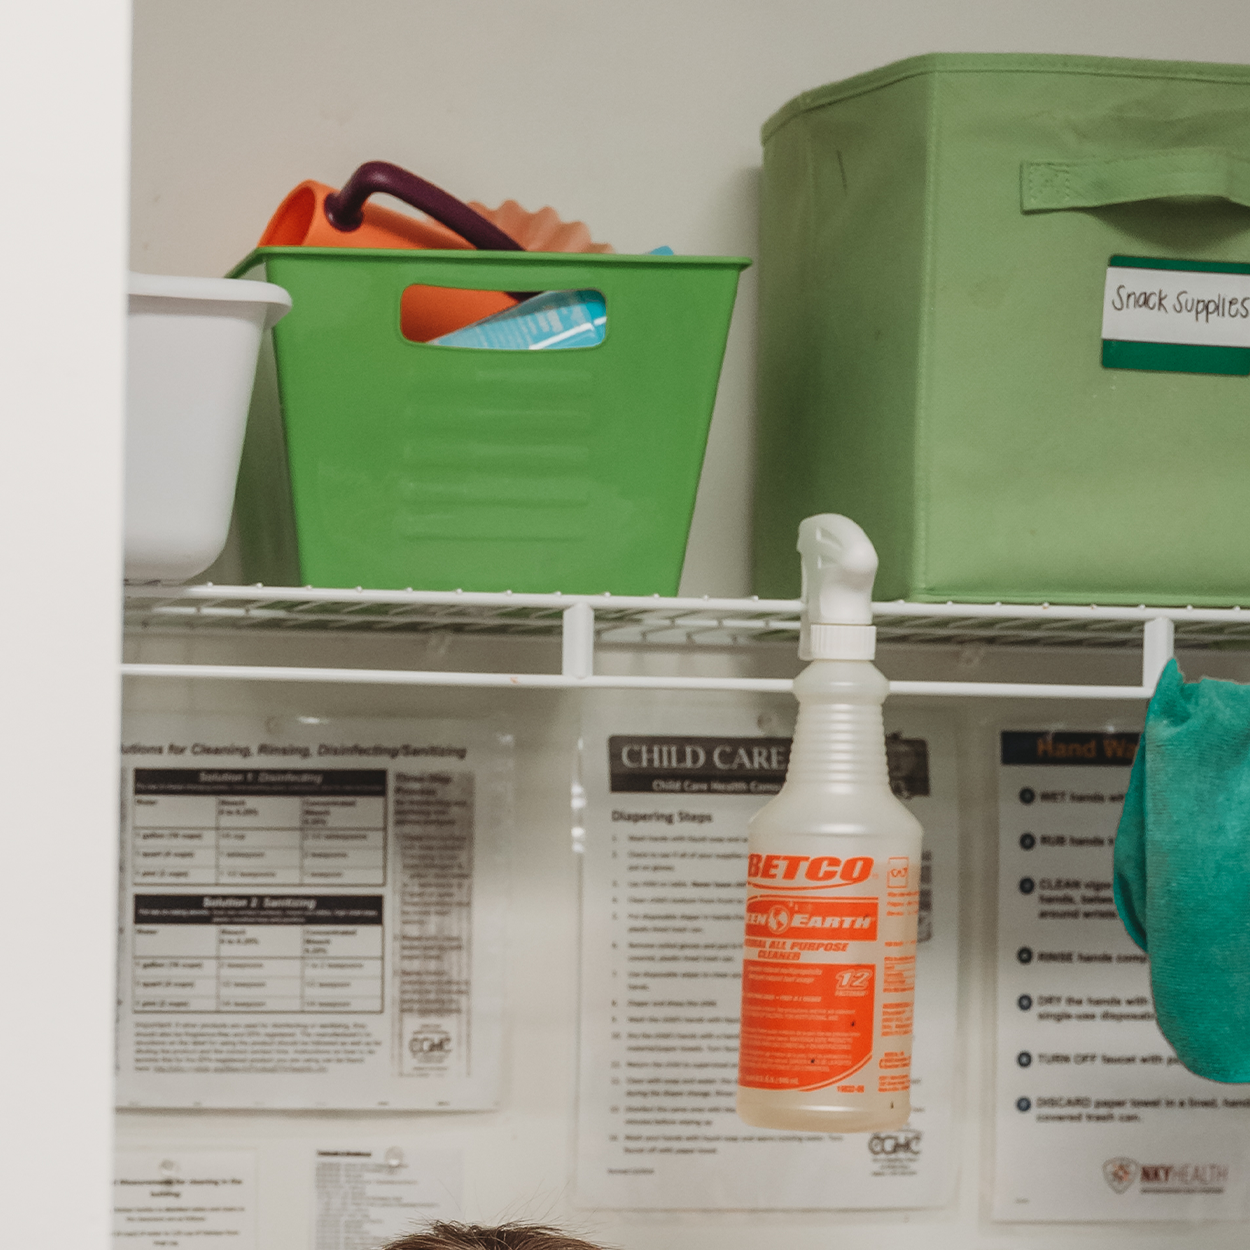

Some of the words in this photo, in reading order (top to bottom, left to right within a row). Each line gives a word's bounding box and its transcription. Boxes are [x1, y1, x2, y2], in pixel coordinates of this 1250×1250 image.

[1111, 284, 1169, 314] Snack
[1172, 290, 1250, 324] Supplies
[167, 742, 188, 756] for
[190, 742, 253, 759] Cleaning,
[257, 743, 311, 760] Rinsing,
[1036, 737, 1097, 758] Hand
[620, 744, 706, 770] CHILD
[712, 745, 787, 771] CARE
[652, 779, 682, 792] Child
[682, 779, 709, 792] Care
[611, 810, 674, 825] Diapering
[677, 810, 713, 825] Steps
[747, 853, 875, 882] BETCO
[202, 896, 249, 909] Solution
[262, 896, 317, 912] Sanitizing
[790, 913, 872, 929] EARTH
[789, 941, 849, 953] PURPOSE
[838, 970, 871, 988] 12
[1036, 1096, 1092, 1109] DISCARD
